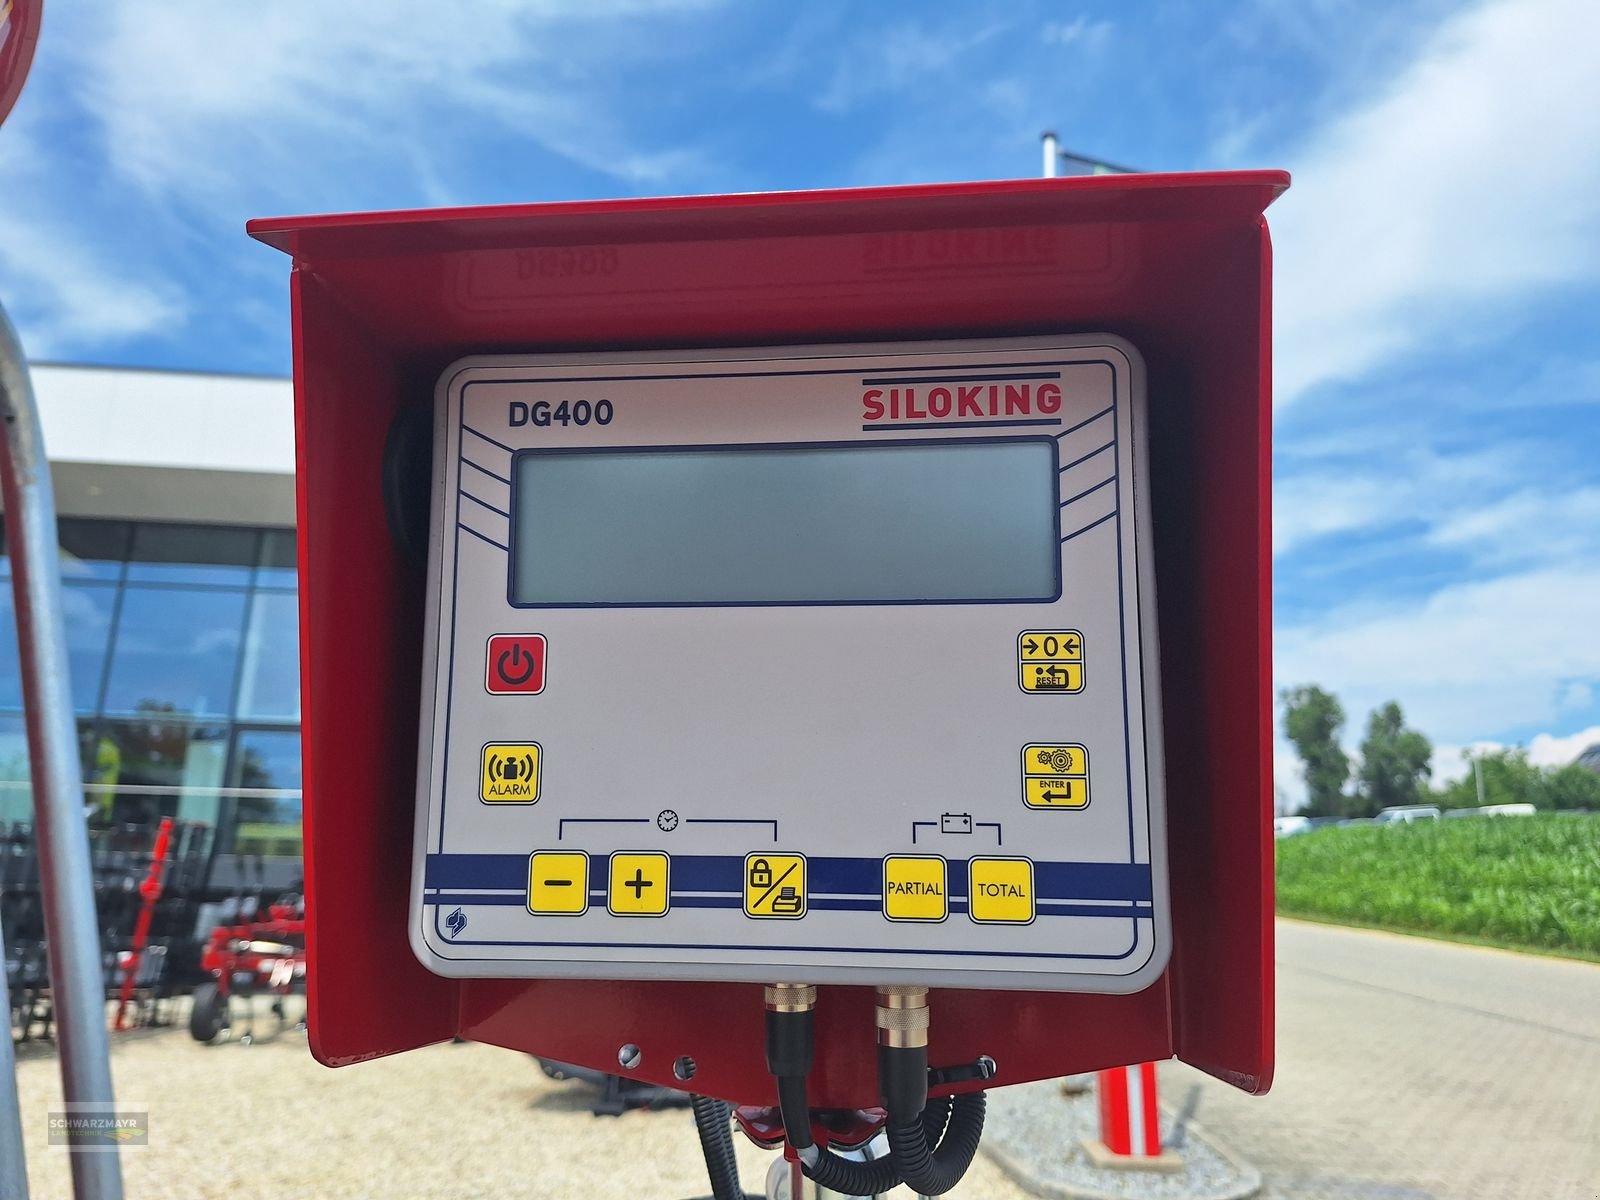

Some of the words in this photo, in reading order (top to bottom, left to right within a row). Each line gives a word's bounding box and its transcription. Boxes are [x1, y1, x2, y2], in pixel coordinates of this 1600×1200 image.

[862, 383, 1061, 420] SILOKING
[509, 399, 613, 427] DG400
[1036, 676, 1061, 685] RESET
[489, 784, 531, 795] ALARM
[1040, 780, 1065, 788] ENTER
[888, 881, 943, 896] PARTIAL
[978, 883, 1025, 897] TOTAL
